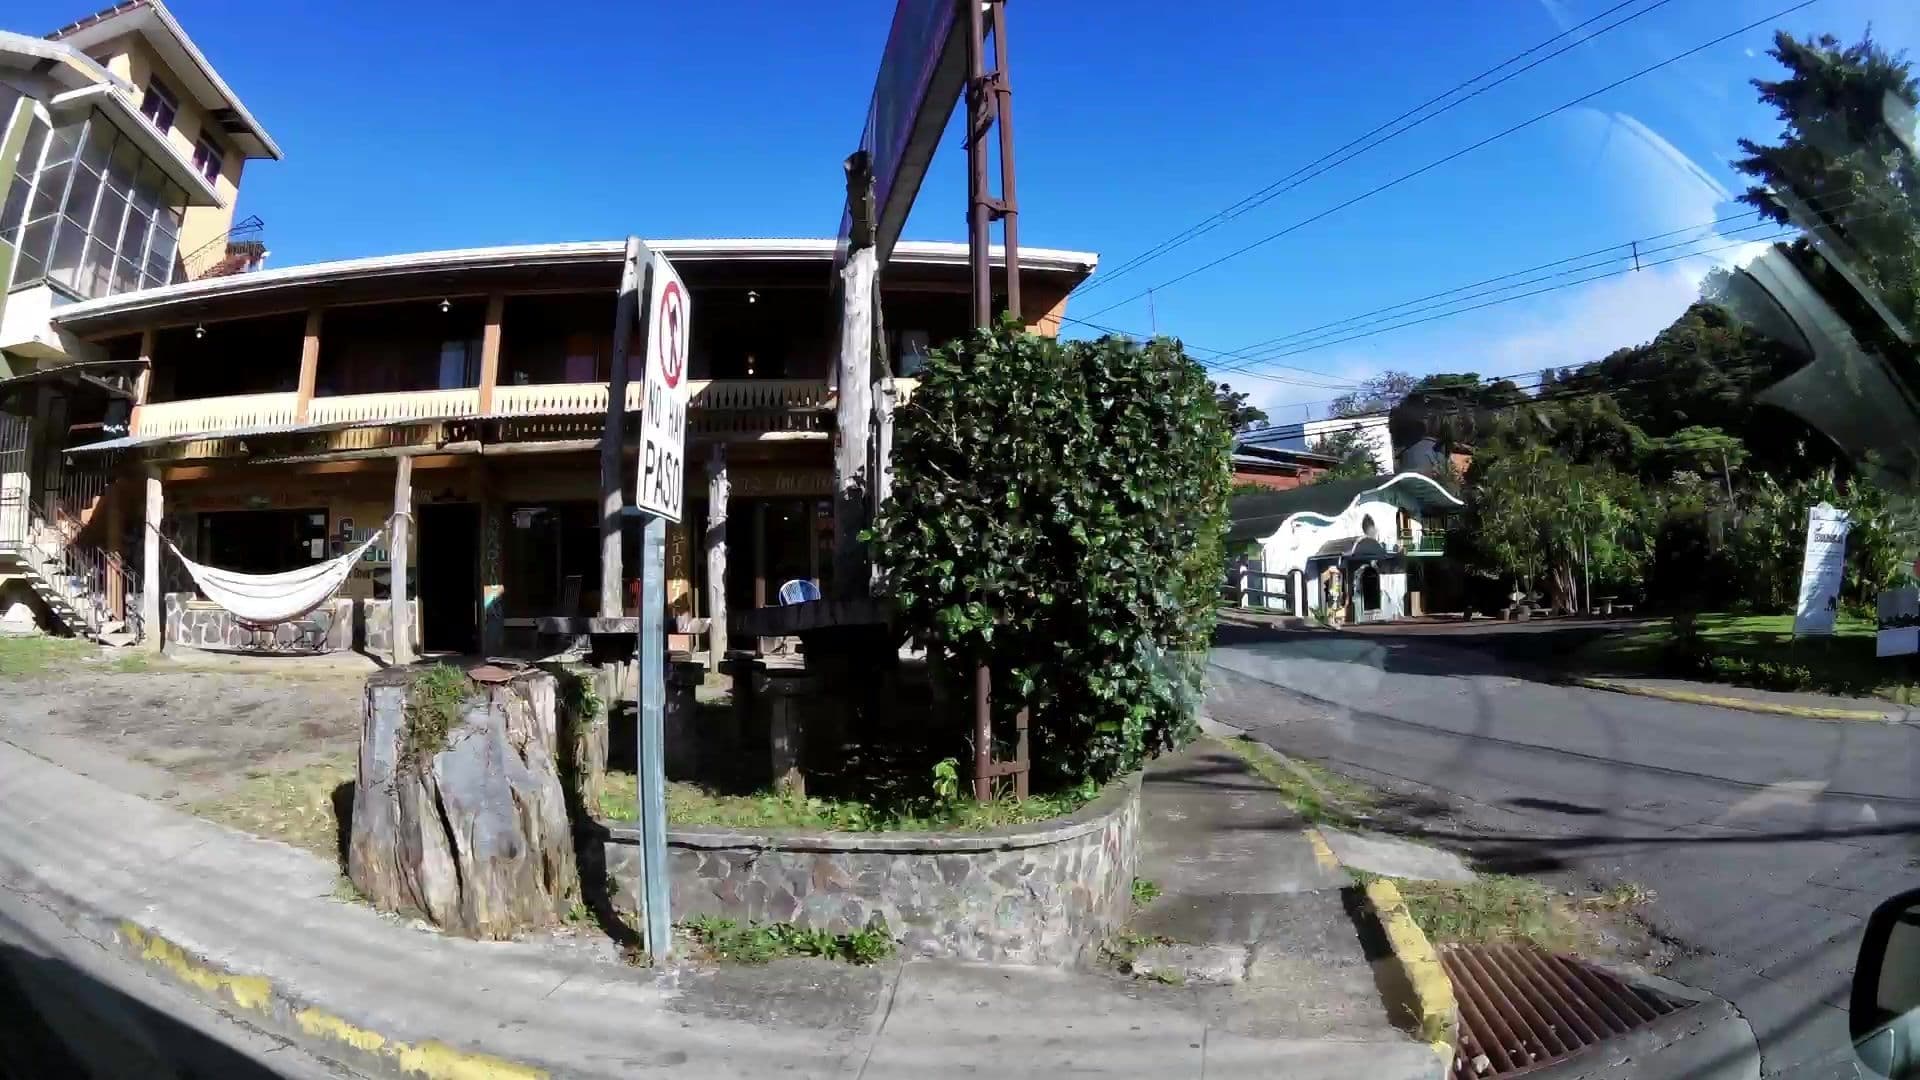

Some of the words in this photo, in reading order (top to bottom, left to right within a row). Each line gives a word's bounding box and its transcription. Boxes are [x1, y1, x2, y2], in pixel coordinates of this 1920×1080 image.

[648, 380, 661, 428] NO
[668, 396, 683, 445] HAY
[643, 439, 680, 512] PASO
